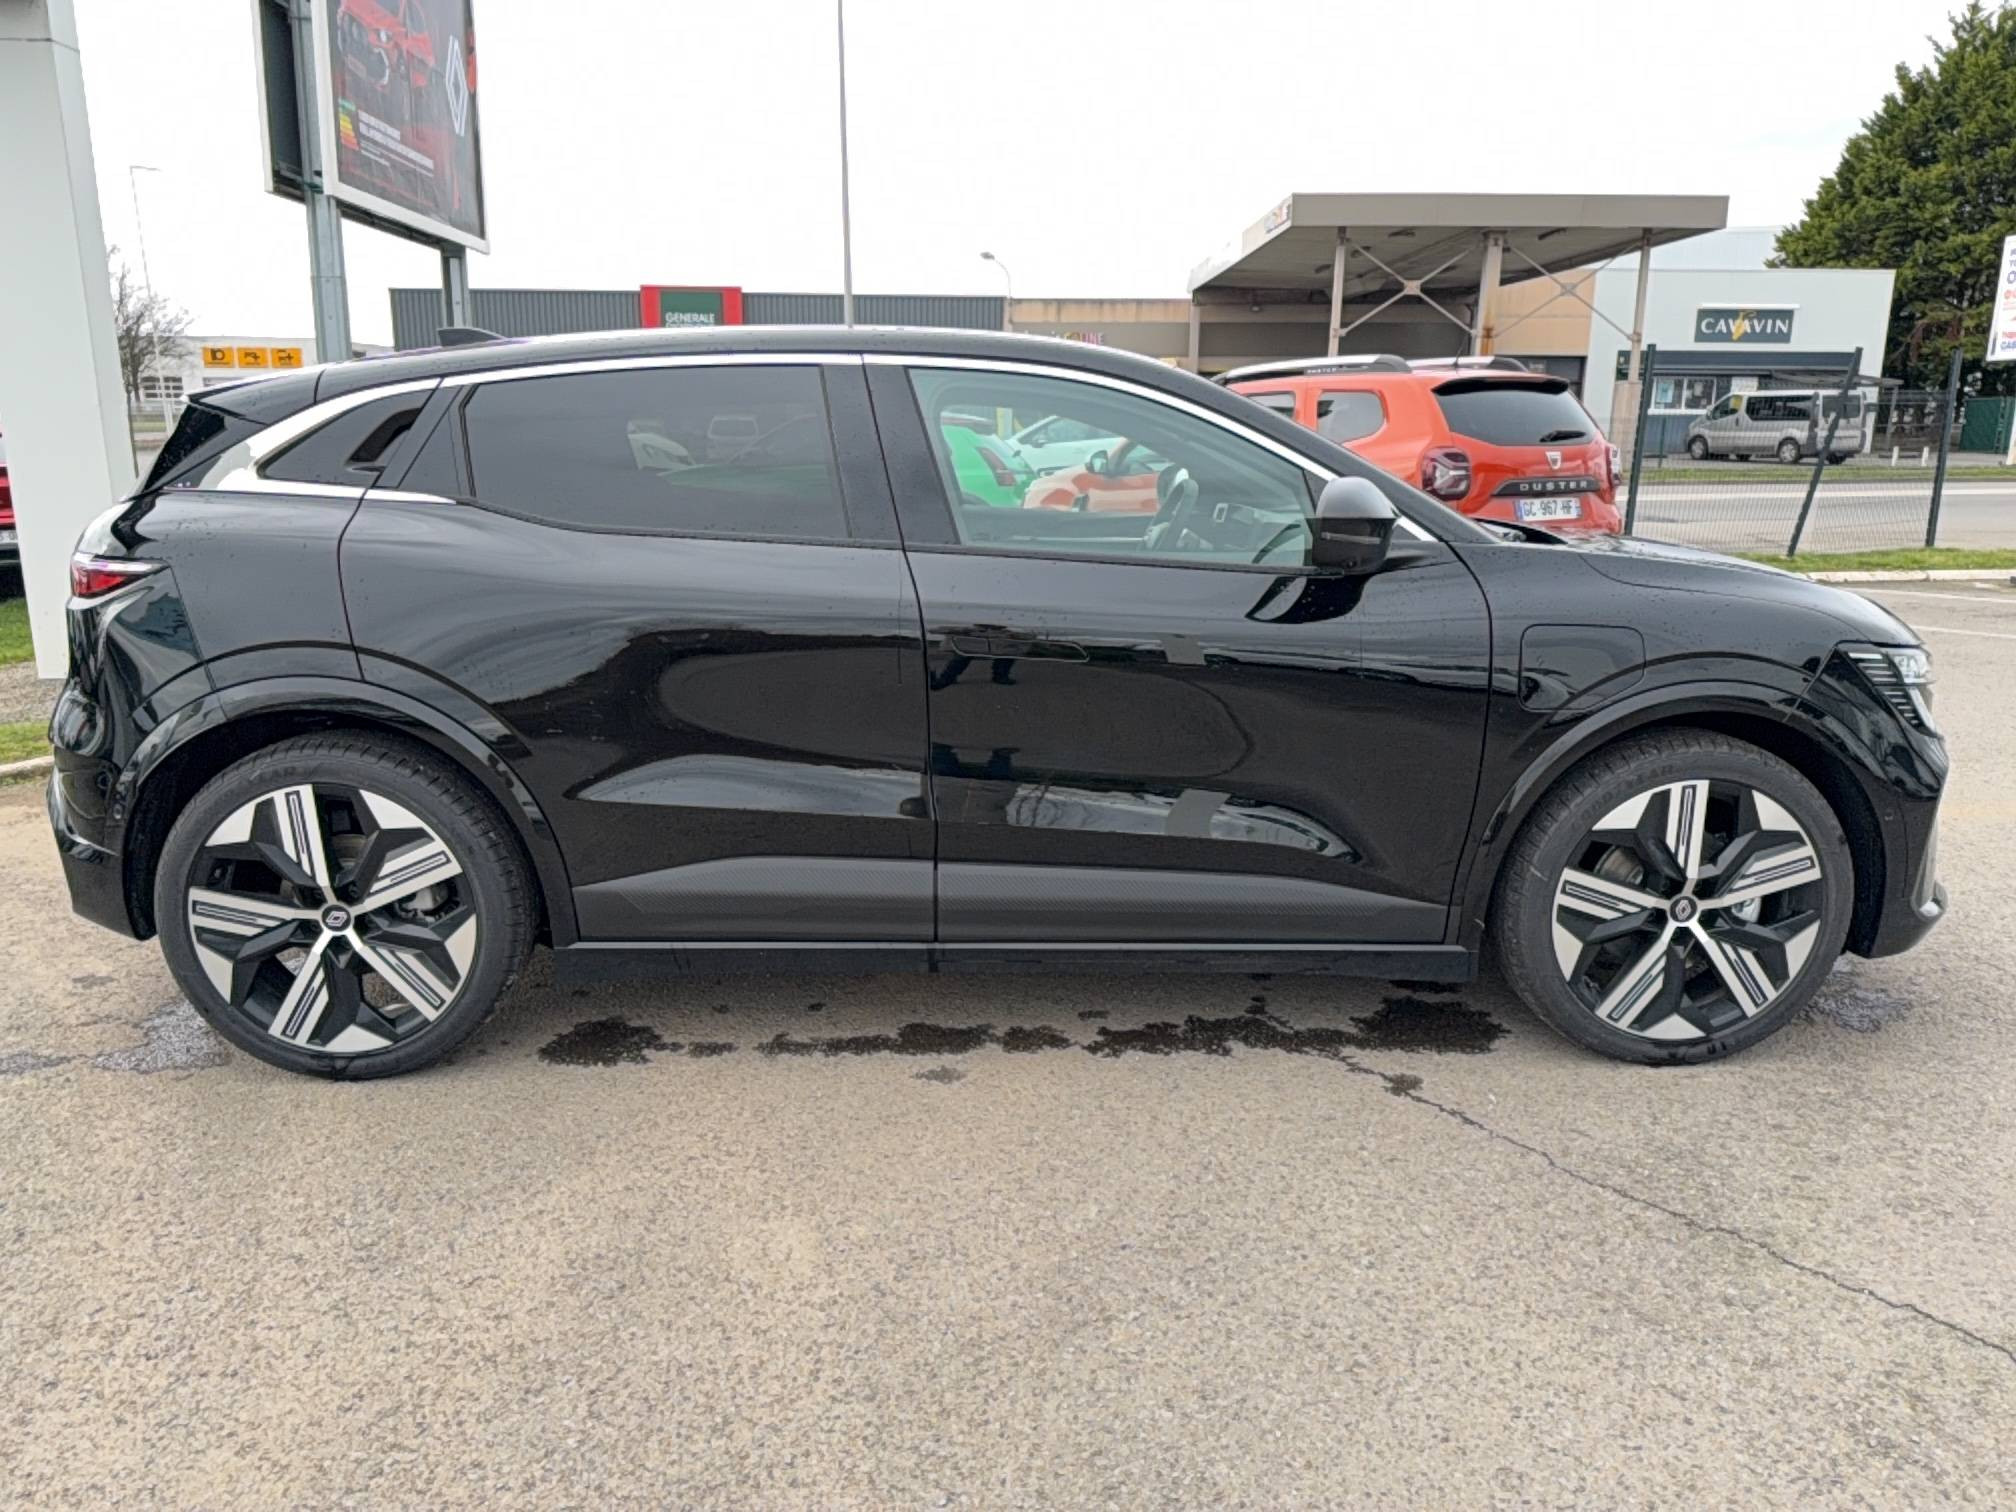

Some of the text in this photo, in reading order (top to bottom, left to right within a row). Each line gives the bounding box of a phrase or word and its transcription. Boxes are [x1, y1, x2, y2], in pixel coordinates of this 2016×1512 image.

[665, 312, 715, 324] GENERALE
[1701, 318, 1789, 334] CAVAVIN
[1520, 481, 1588, 492] DUSTER
